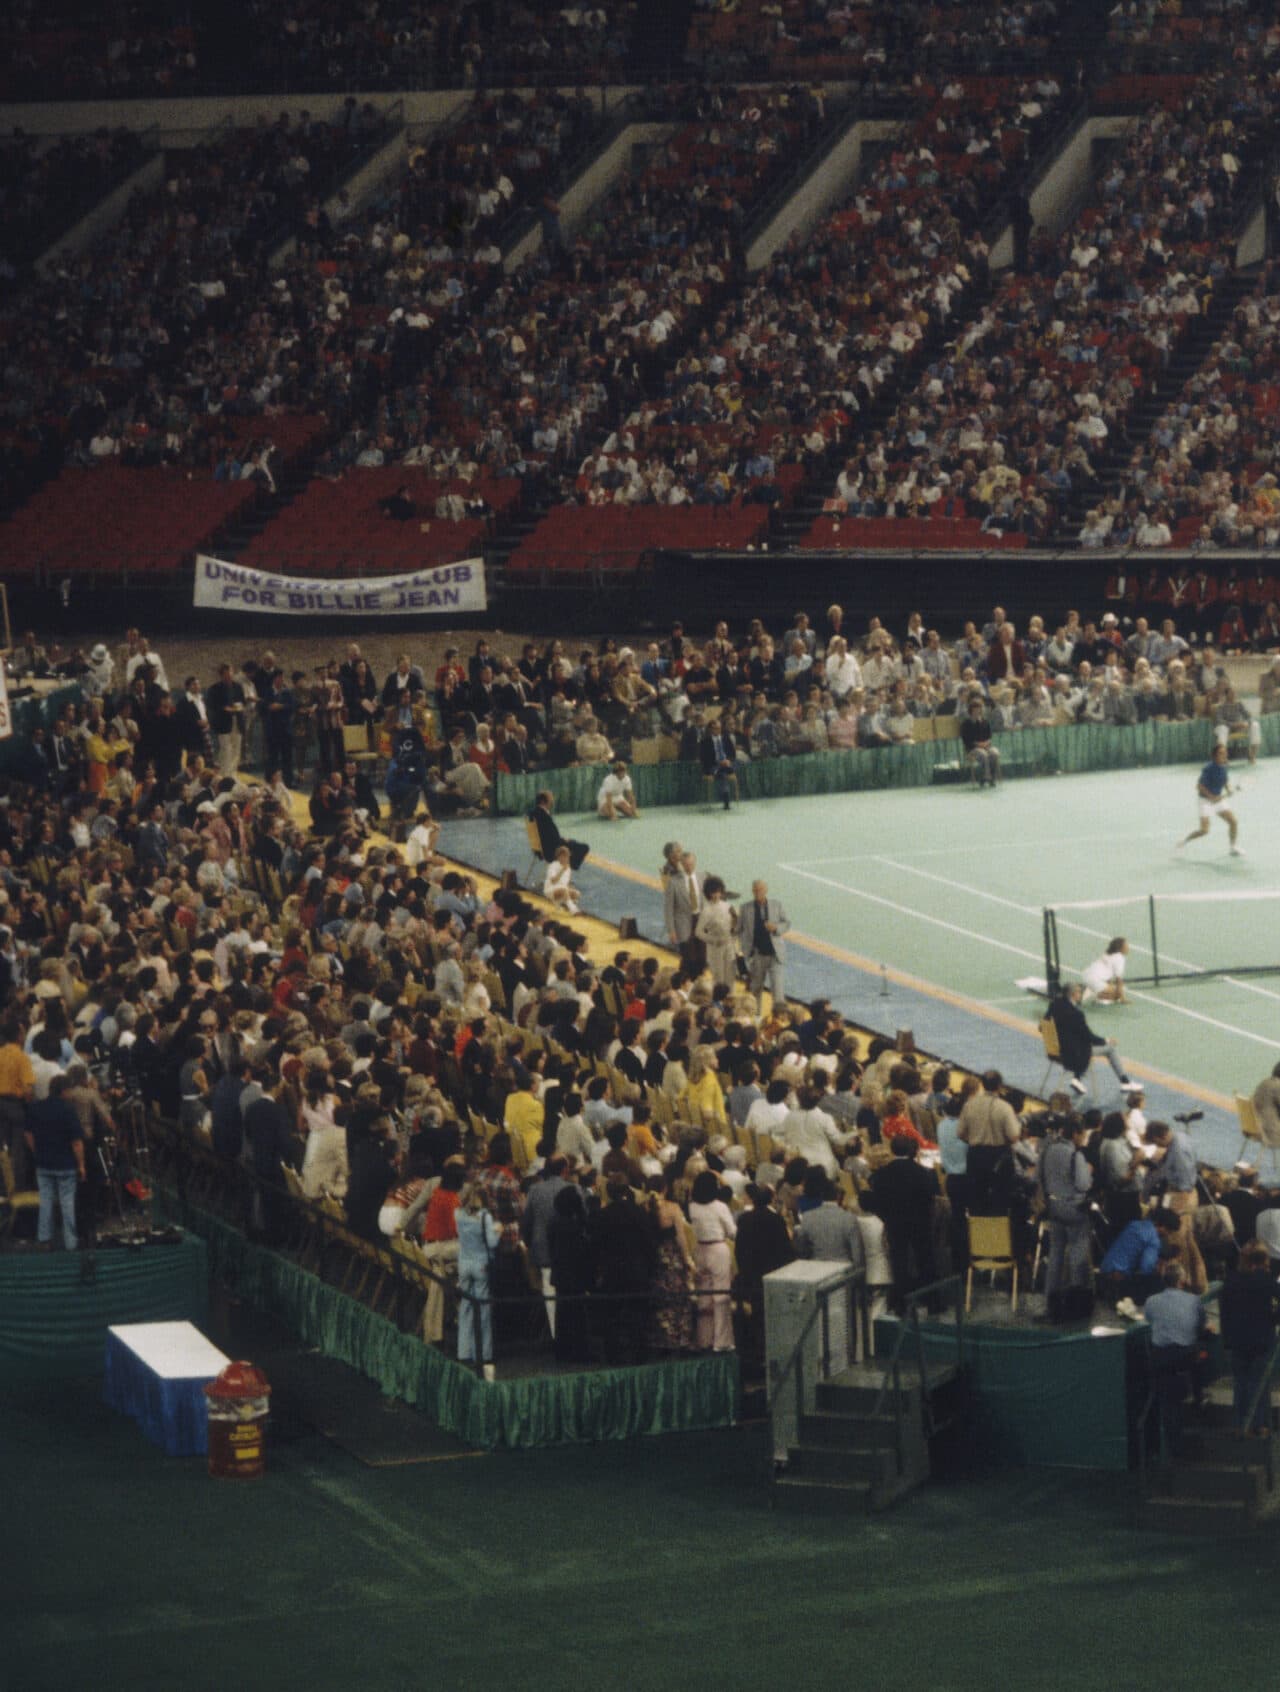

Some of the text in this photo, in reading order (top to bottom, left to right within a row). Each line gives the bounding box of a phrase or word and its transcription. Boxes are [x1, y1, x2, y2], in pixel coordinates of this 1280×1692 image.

[205, 561, 364, 590] UNIVE
[222, 585, 459, 610] FOR BILLIE JEAN
